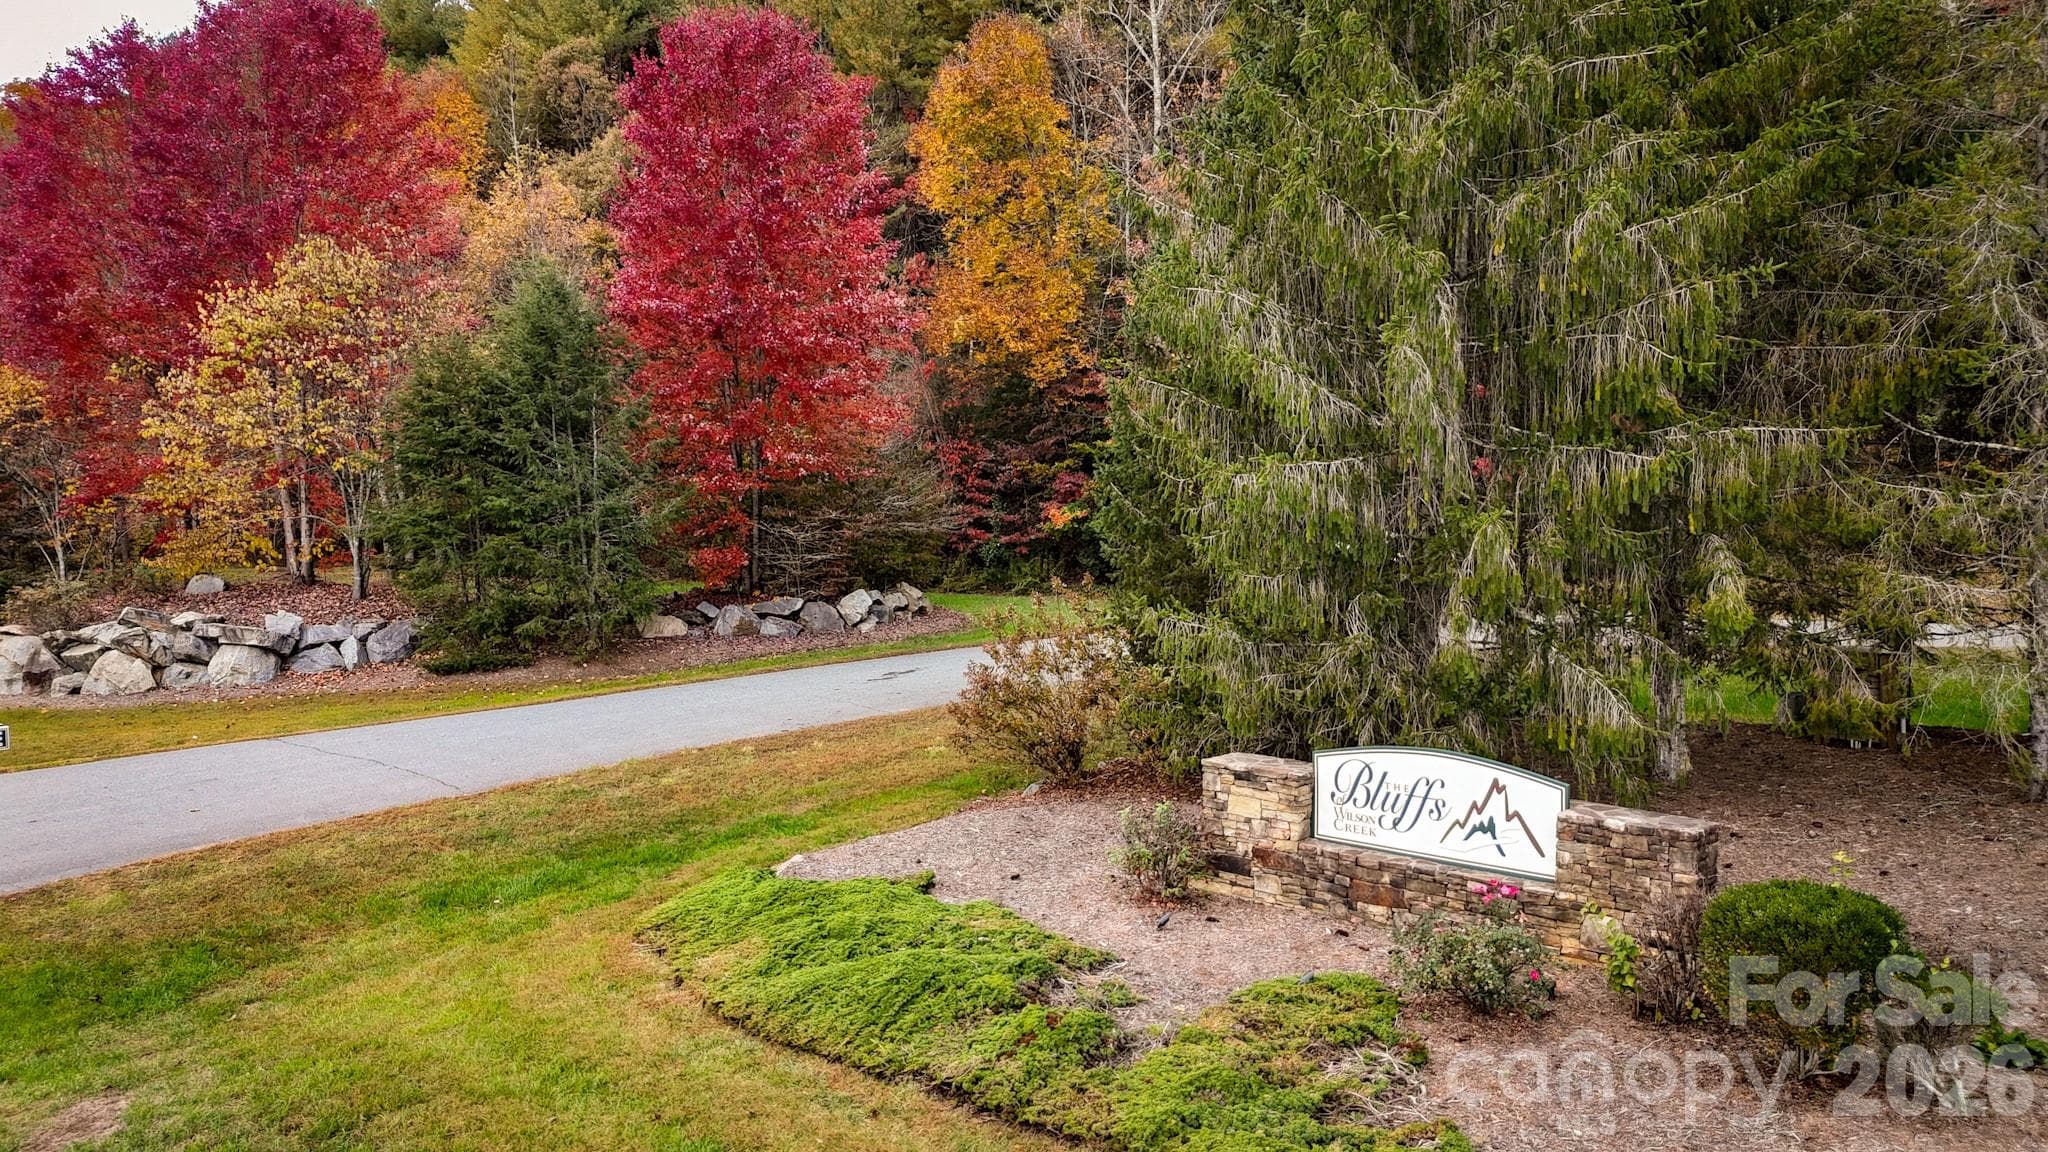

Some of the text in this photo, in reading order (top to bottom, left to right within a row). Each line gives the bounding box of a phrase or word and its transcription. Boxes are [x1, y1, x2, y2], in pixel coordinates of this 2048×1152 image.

[1331, 759, 1452, 833] Bluffs
[1384, 782, 1410, 792] THE
[1334, 806, 1376, 824] WILSON
[1334, 819, 1376, 837] CREEK
